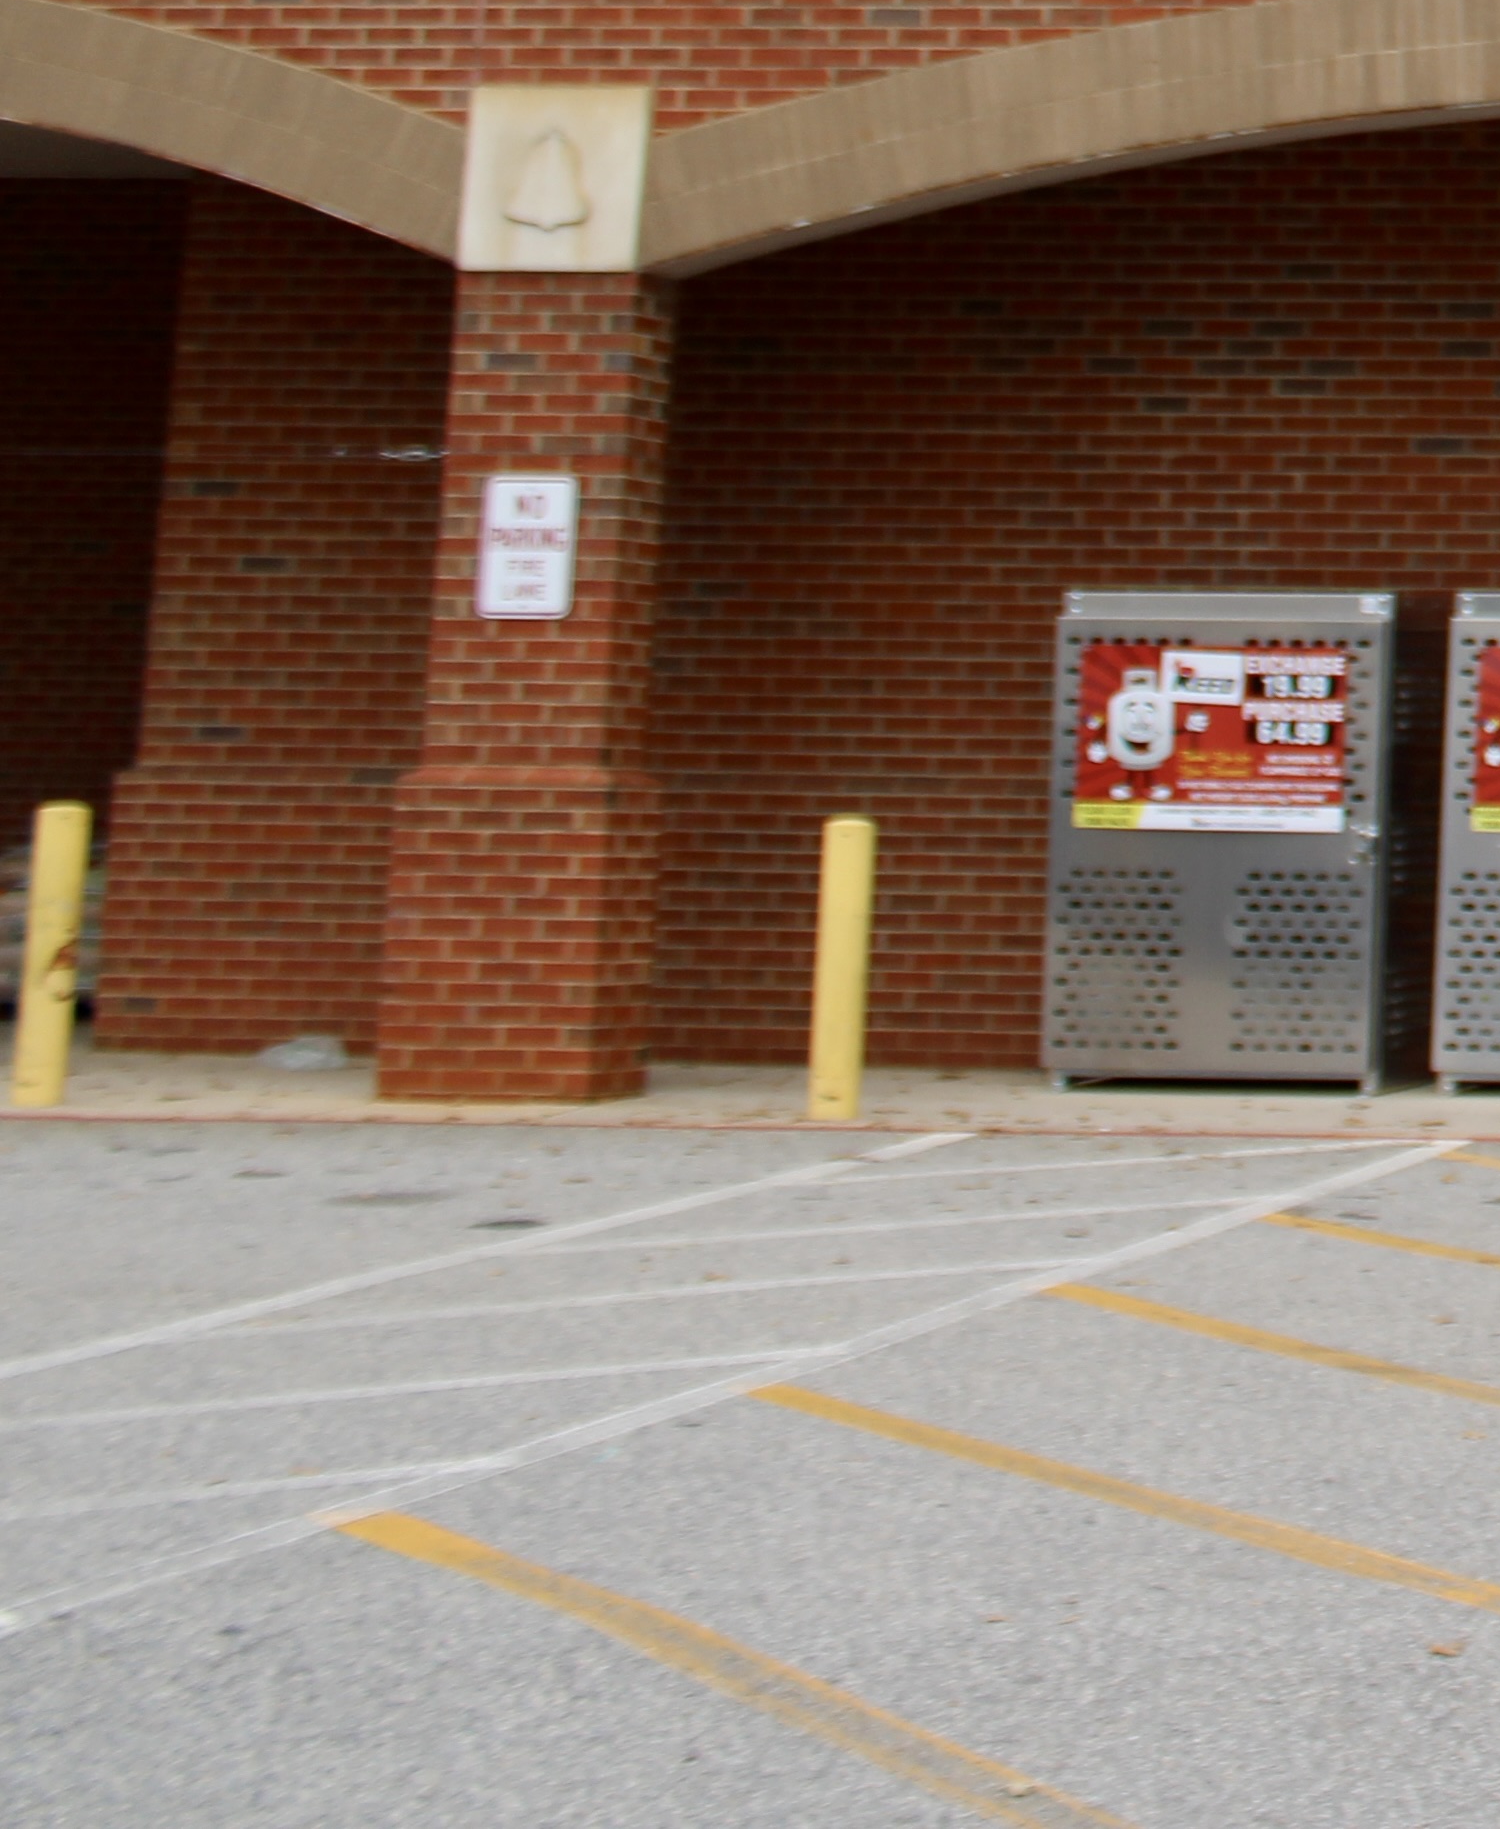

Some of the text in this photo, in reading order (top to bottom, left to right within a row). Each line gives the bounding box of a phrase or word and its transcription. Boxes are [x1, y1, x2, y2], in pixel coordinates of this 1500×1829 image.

[515, 494, 546, 520] NO
[489, 527, 569, 552] PARKING
[505, 559, 546, 577] FIRE
[502, 584, 548, 602] LANE
